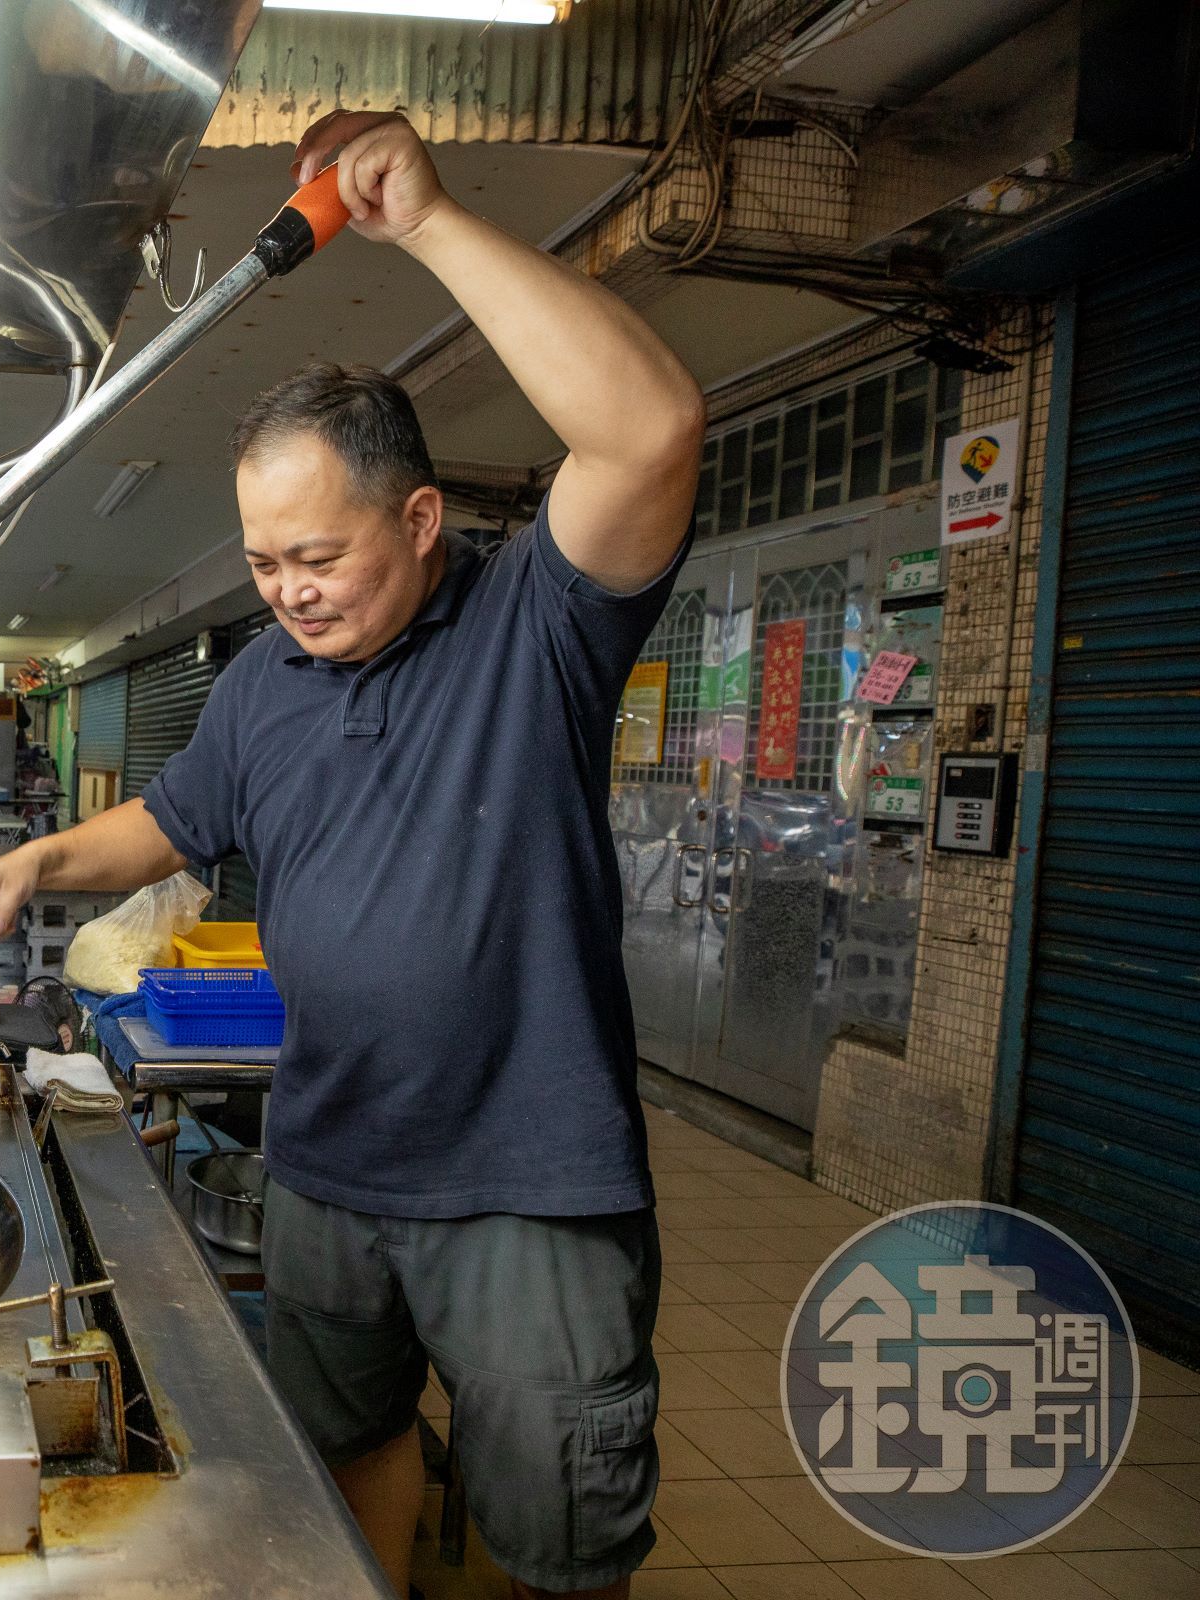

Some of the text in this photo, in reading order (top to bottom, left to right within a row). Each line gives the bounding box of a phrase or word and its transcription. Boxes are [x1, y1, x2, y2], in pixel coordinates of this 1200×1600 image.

[947, 481, 1009, 511] 防空避難
[903, 571, 922, 588] 53
[885, 796, 904, 812] 53
